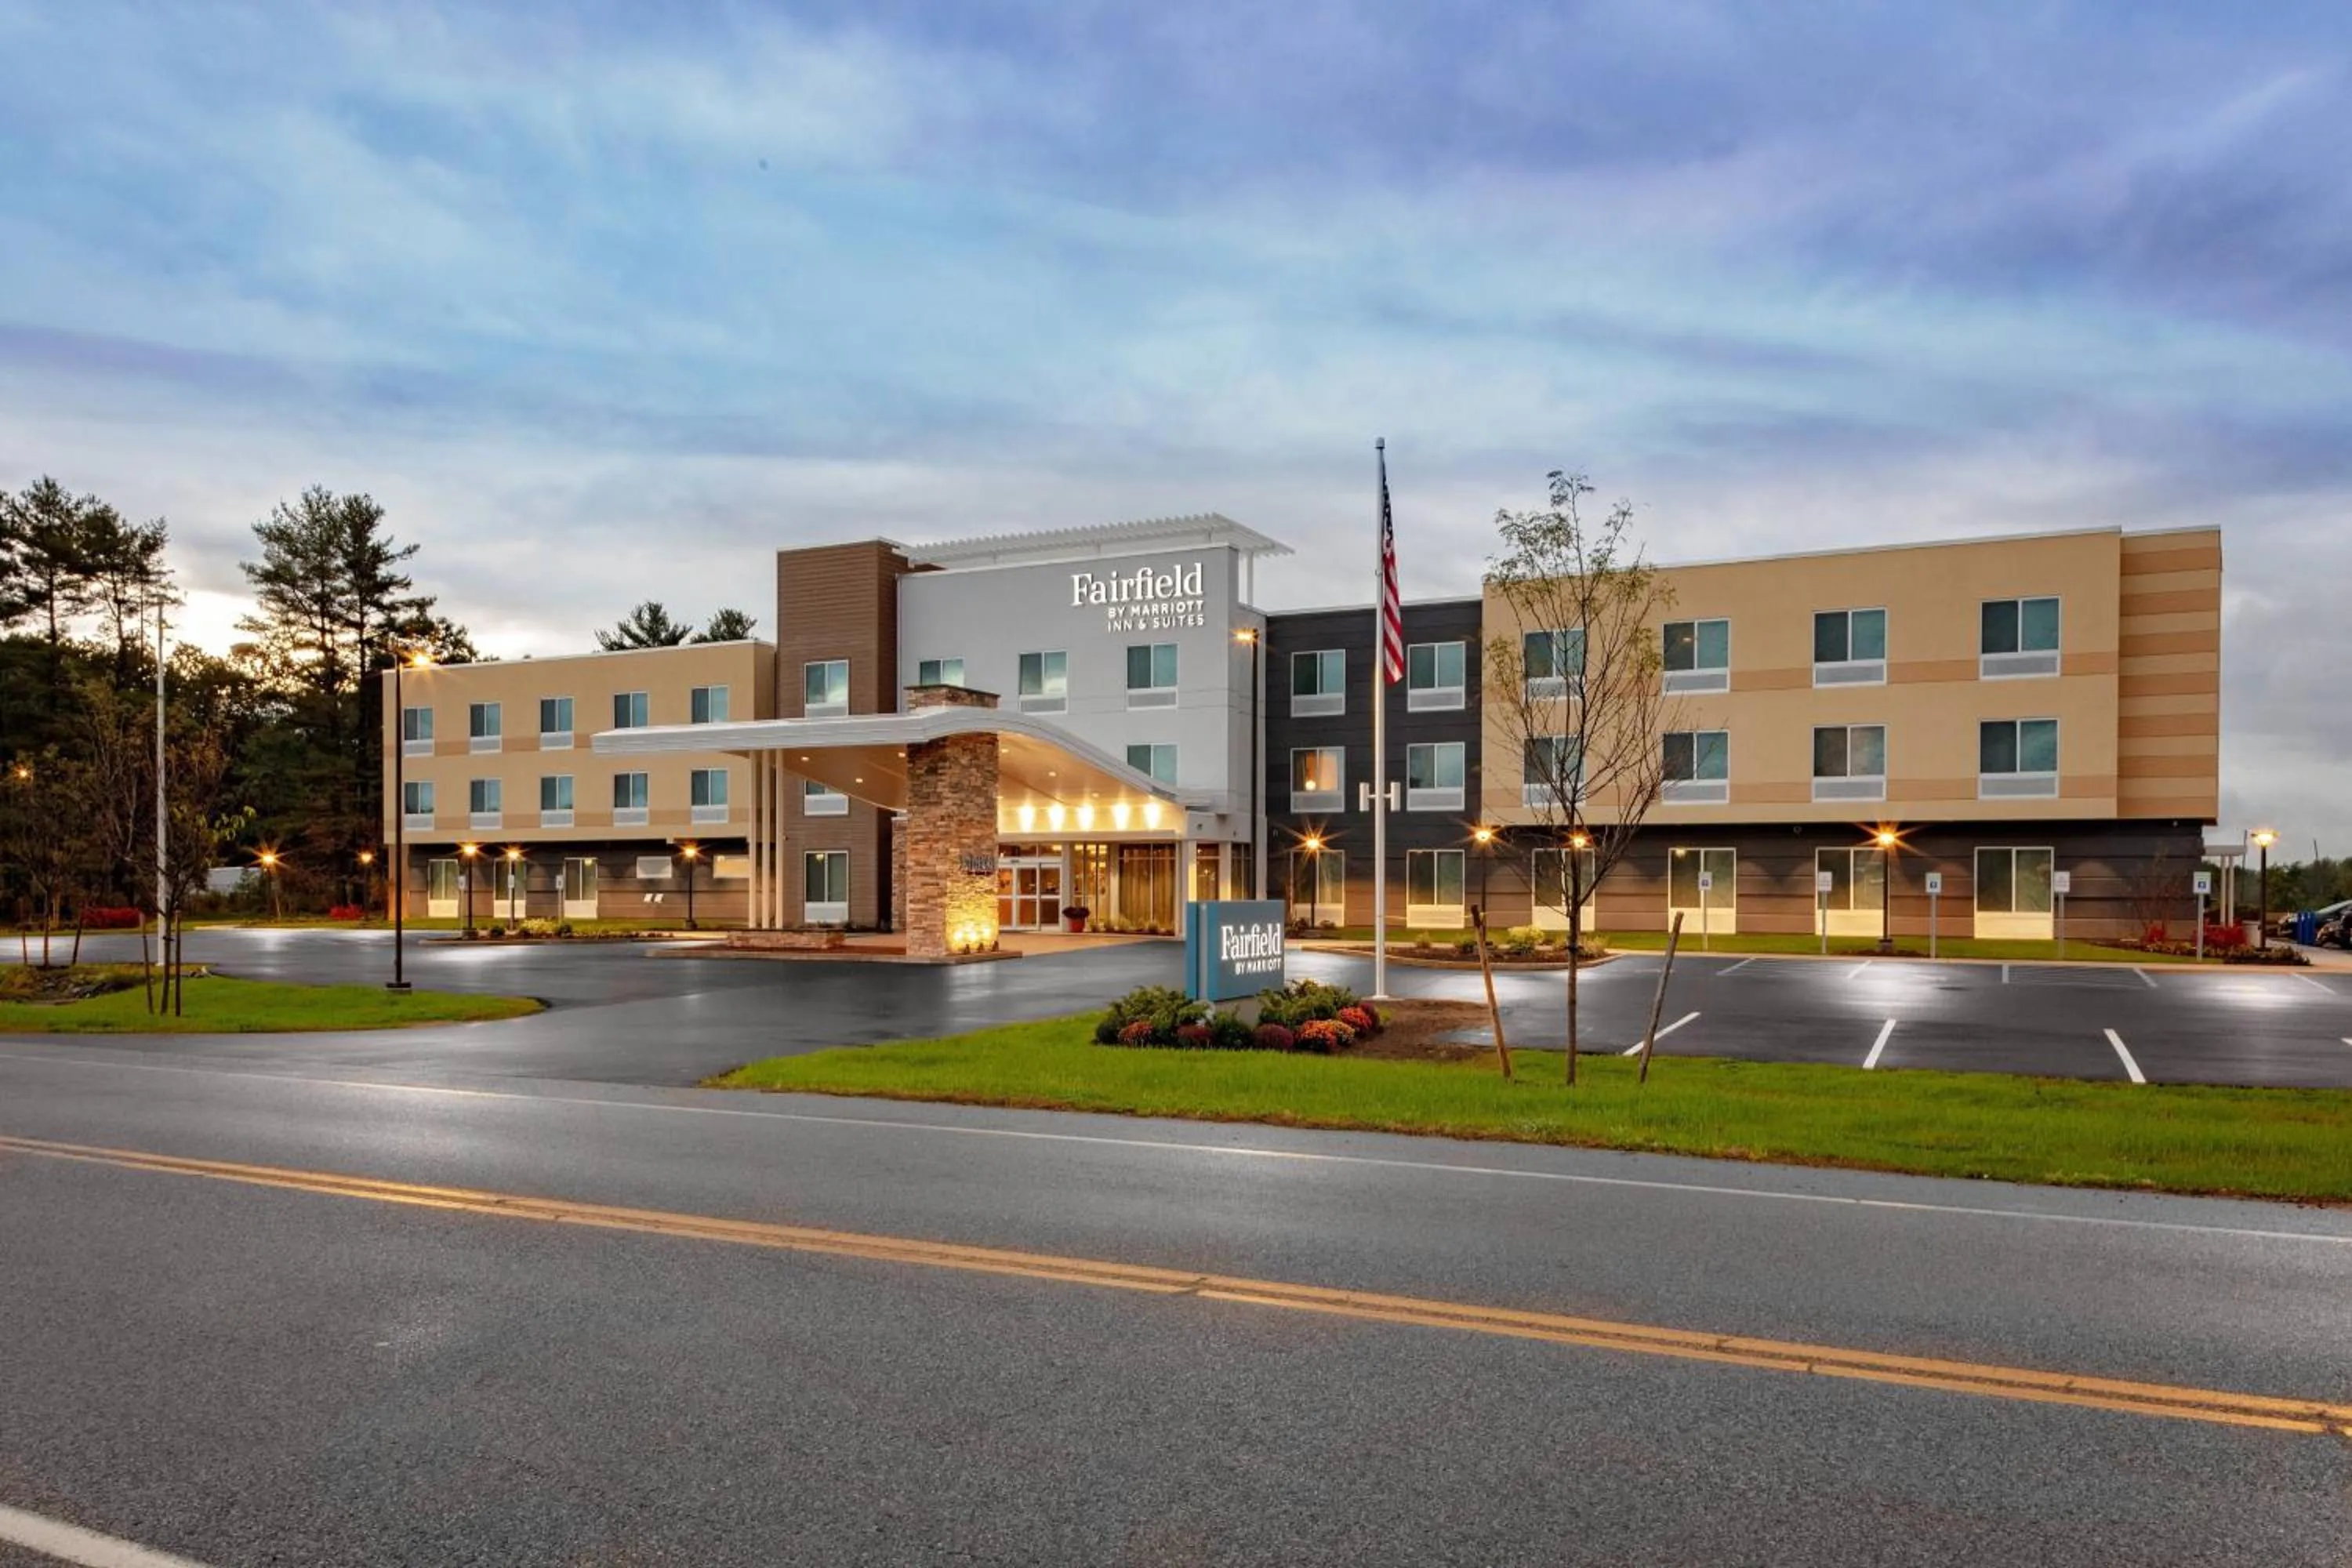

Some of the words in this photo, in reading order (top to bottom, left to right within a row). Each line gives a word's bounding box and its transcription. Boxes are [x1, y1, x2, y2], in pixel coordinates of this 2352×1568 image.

[1070, 562, 1203, 606] Fairfield
[1108, 606, 1125, 619] BY
[1131, 600, 1204, 617] MARRIOTT
[1108, 619, 1133, 633] INN
[1138, 618, 1147, 631] &
[1152, 614, 1204, 629] SUITES
[1221, 923, 1282, 960] Fairfield
[1235, 961, 1246, 975] BY
